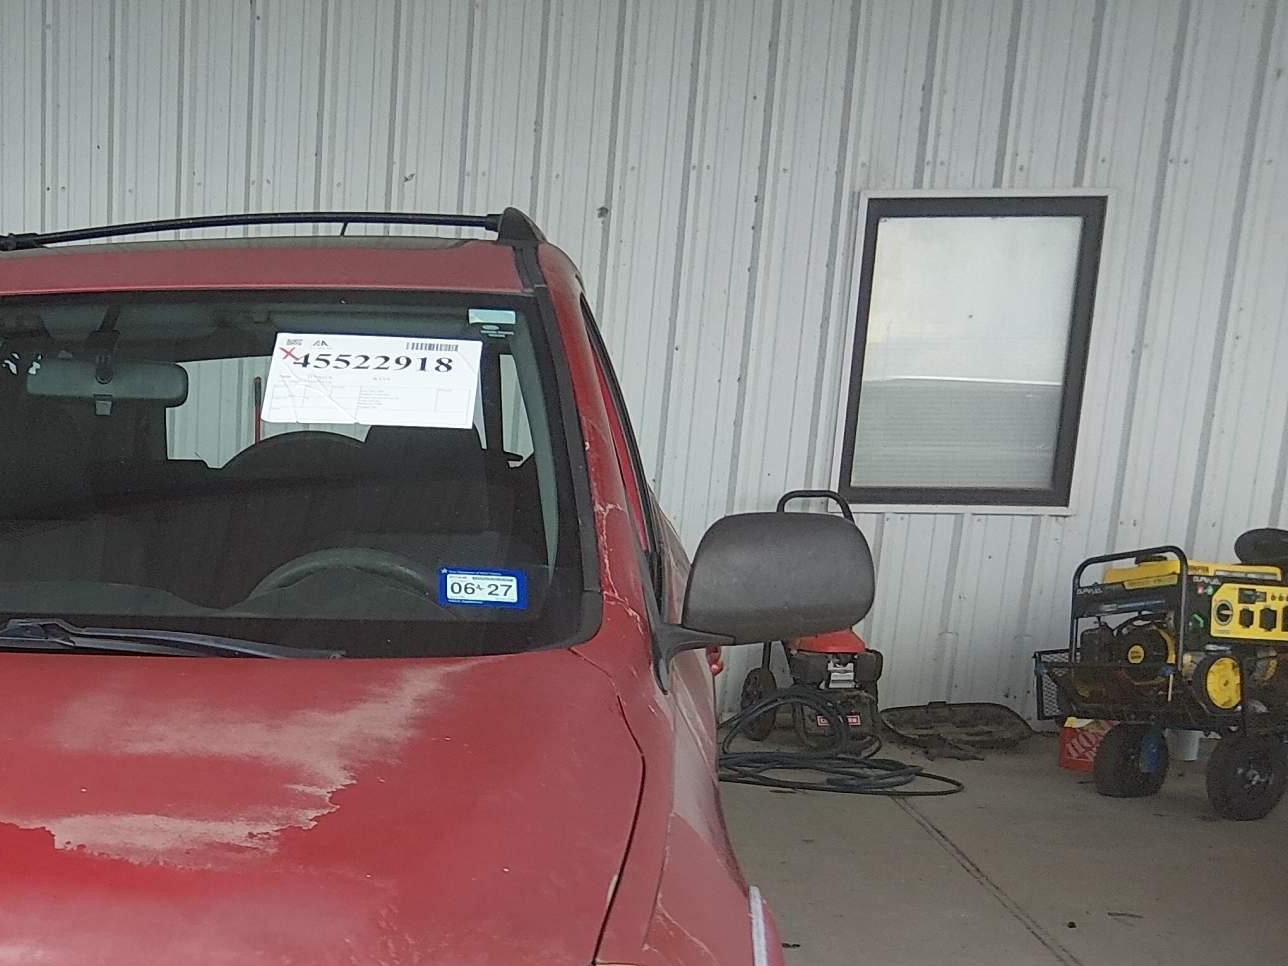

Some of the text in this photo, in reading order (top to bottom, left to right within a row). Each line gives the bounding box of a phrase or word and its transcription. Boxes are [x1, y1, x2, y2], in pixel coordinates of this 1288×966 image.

[292, 353, 454, 373] 45522918
[450, 582, 513, 597] 06 27
